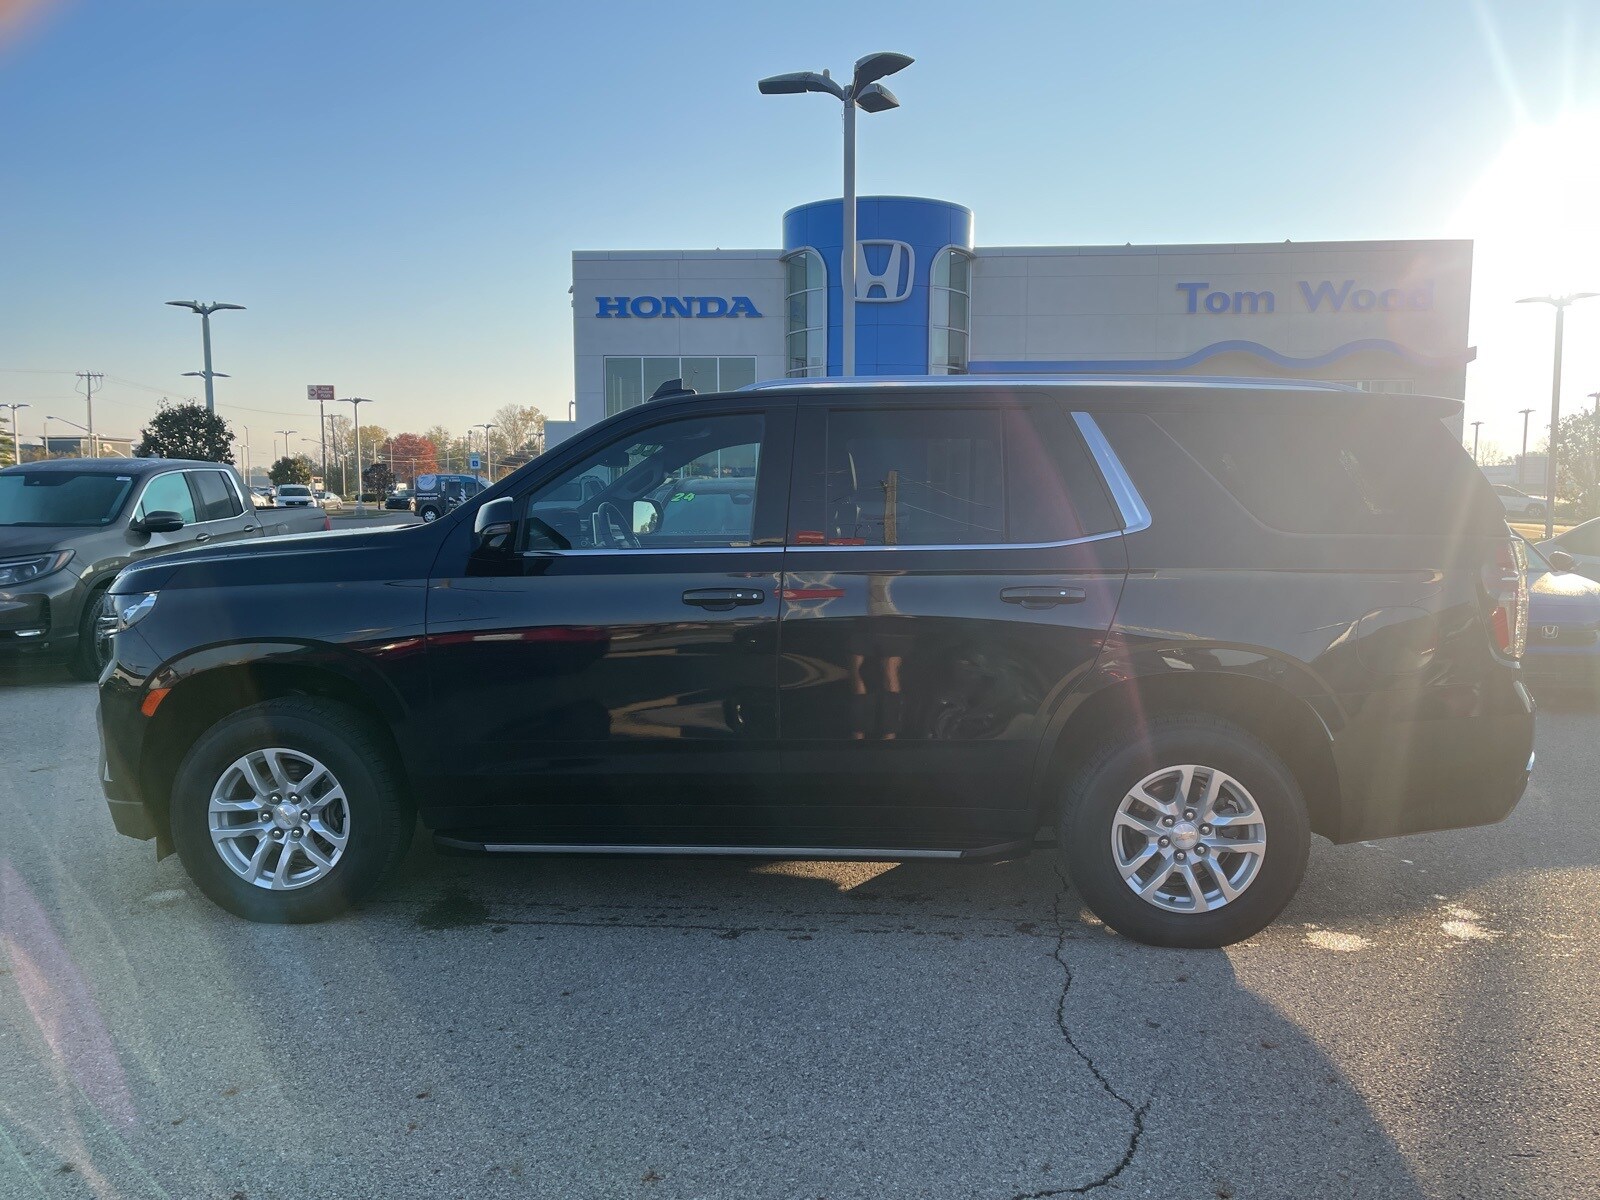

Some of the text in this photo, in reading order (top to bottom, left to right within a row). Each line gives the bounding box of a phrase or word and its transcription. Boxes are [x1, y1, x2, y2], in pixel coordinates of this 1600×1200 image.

[595, 295, 763, 319] HONDA
[1176, 279, 1436, 315] Tom Wood
[670, 492, 696, 502] 24
